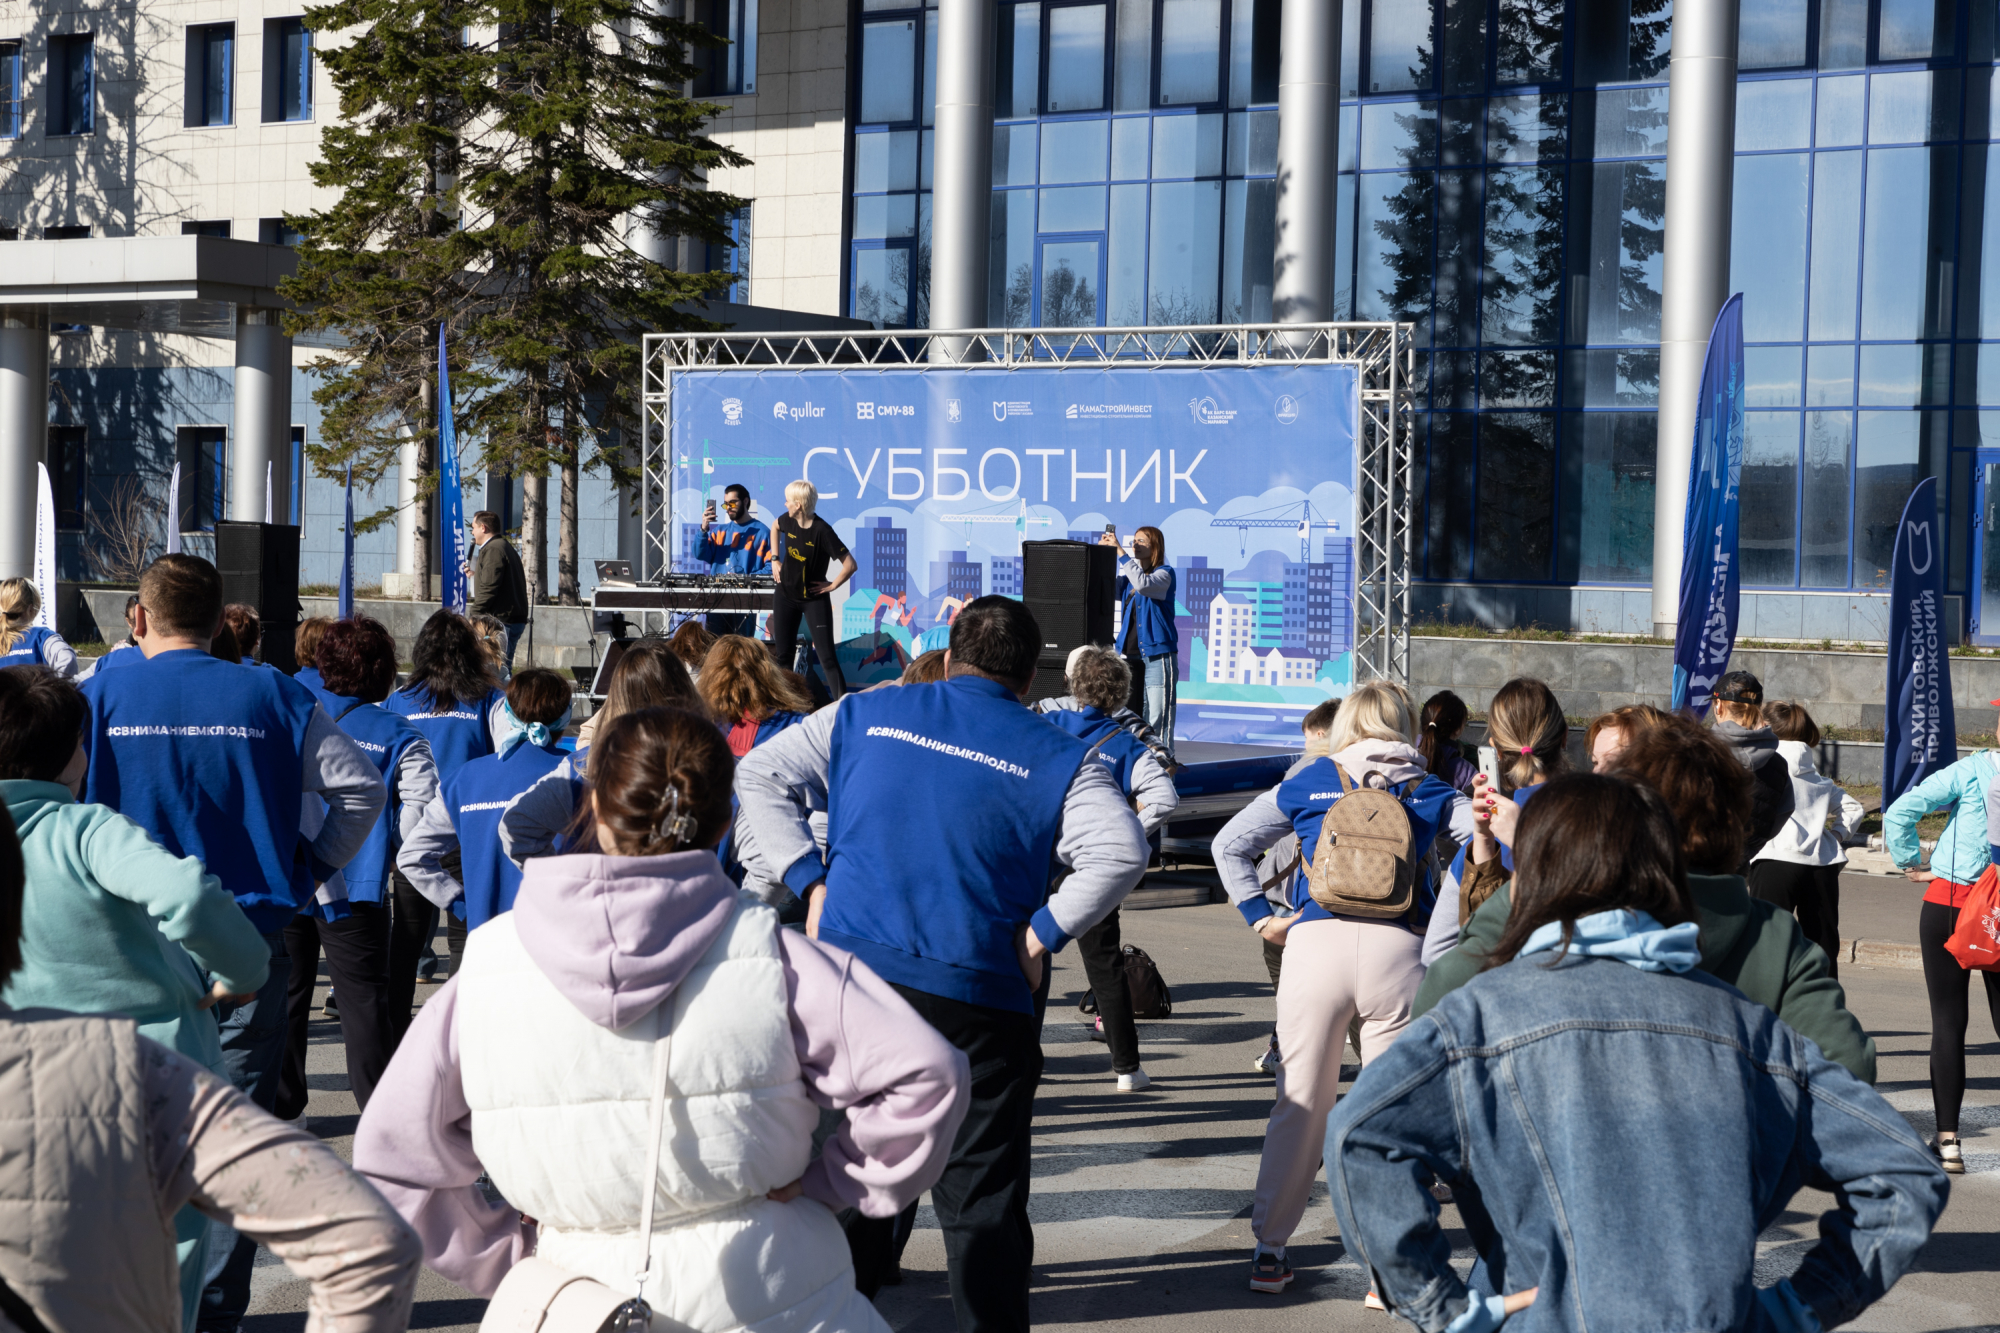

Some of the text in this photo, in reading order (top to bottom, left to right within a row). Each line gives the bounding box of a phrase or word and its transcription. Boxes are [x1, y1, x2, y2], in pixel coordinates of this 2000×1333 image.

[790, 401, 826, 422] qullar
[877, 405, 915, 416] СМУ-88
[803, 447, 1208, 504] СУББОТНИК
[38, 568, 47, 625] МАНИЕМ
[1910, 599, 1926, 764] ВАХИТОВСКИЙ
[1920, 589, 1939, 763] ПРИВОЛЖСКИЙ
[106, 725, 265, 739] #СВНИМАНИЕМКЛЮДЯМ
[866, 726, 1030, 779] #СВНИМАНИЕМКЛЮДЯМ
